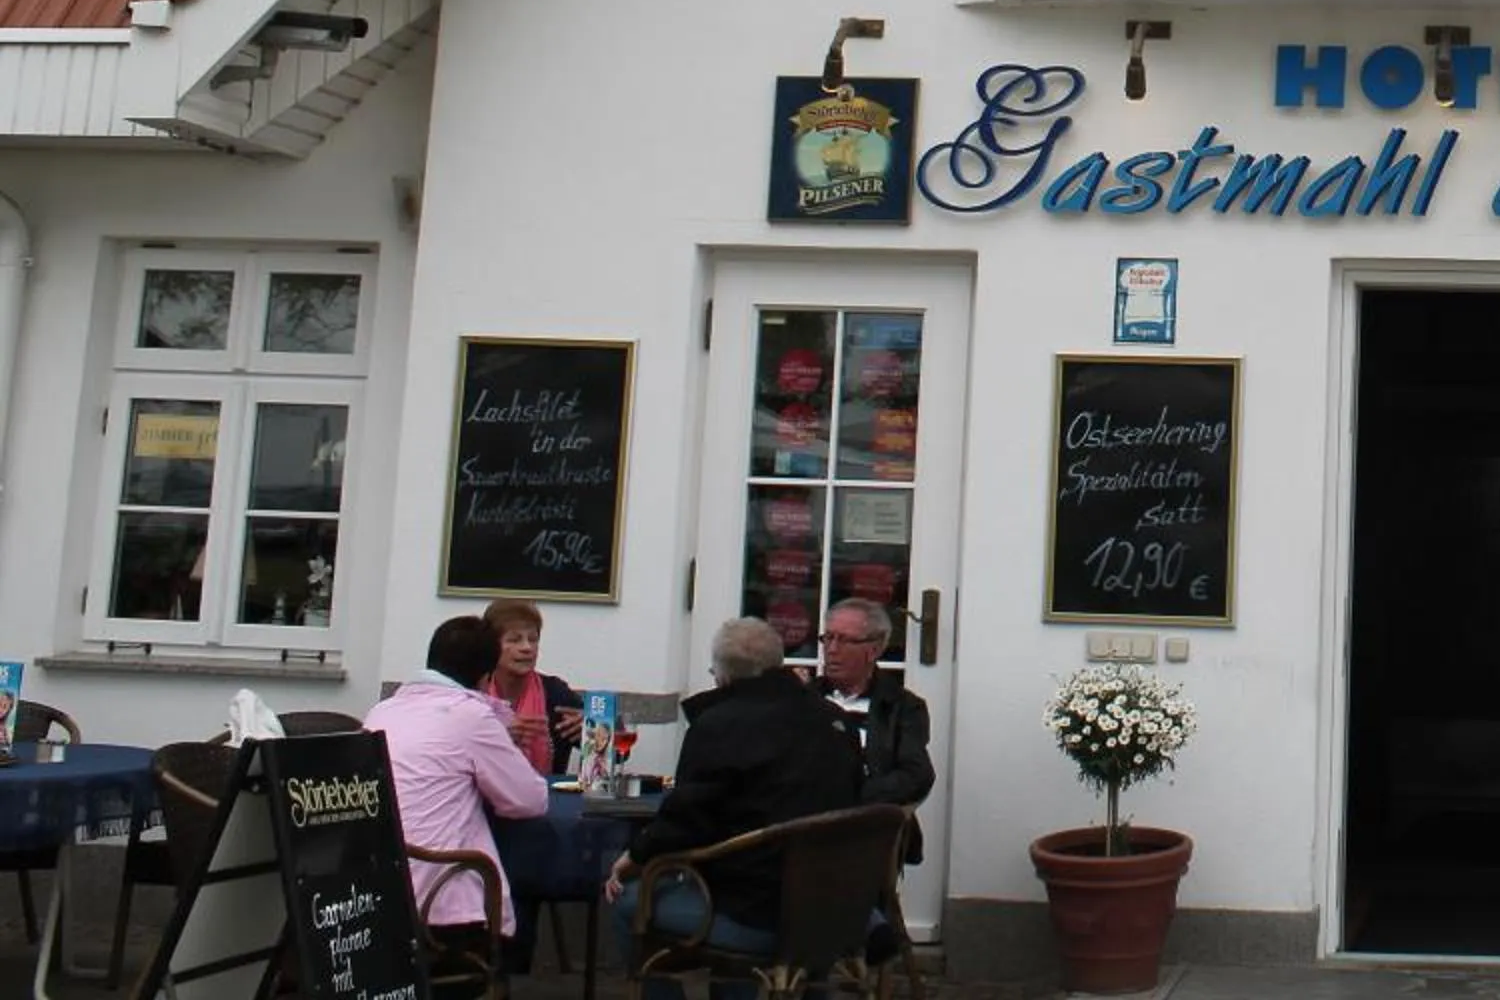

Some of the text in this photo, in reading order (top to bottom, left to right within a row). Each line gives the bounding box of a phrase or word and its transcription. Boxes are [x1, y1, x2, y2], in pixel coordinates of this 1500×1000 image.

[916, 62, 1458, 214] Gastmahl
[797, 177, 885, 208] PILSENER
[1084, 536, 1210, 600] 12,90 €
[287, 775, 379, 828] Störtebeker
